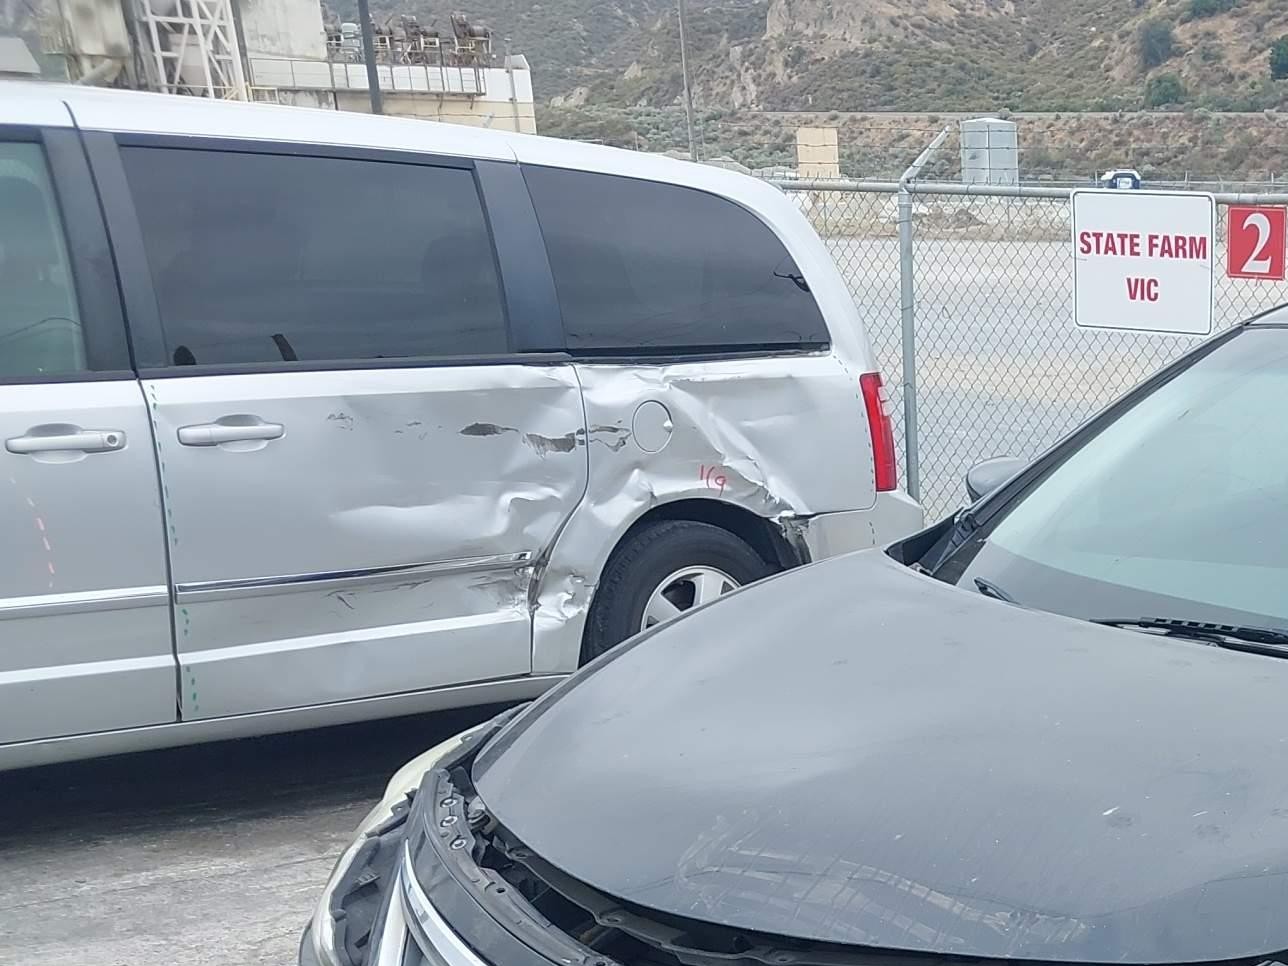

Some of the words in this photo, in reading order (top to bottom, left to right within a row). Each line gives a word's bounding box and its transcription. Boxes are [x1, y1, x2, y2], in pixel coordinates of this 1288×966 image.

[1079, 231, 1140, 257] STATE
[1148, 234, 1207, 260] FARM
[1241, 212, 1272, 274] 2
[1127, 277, 1159, 302] VIC
